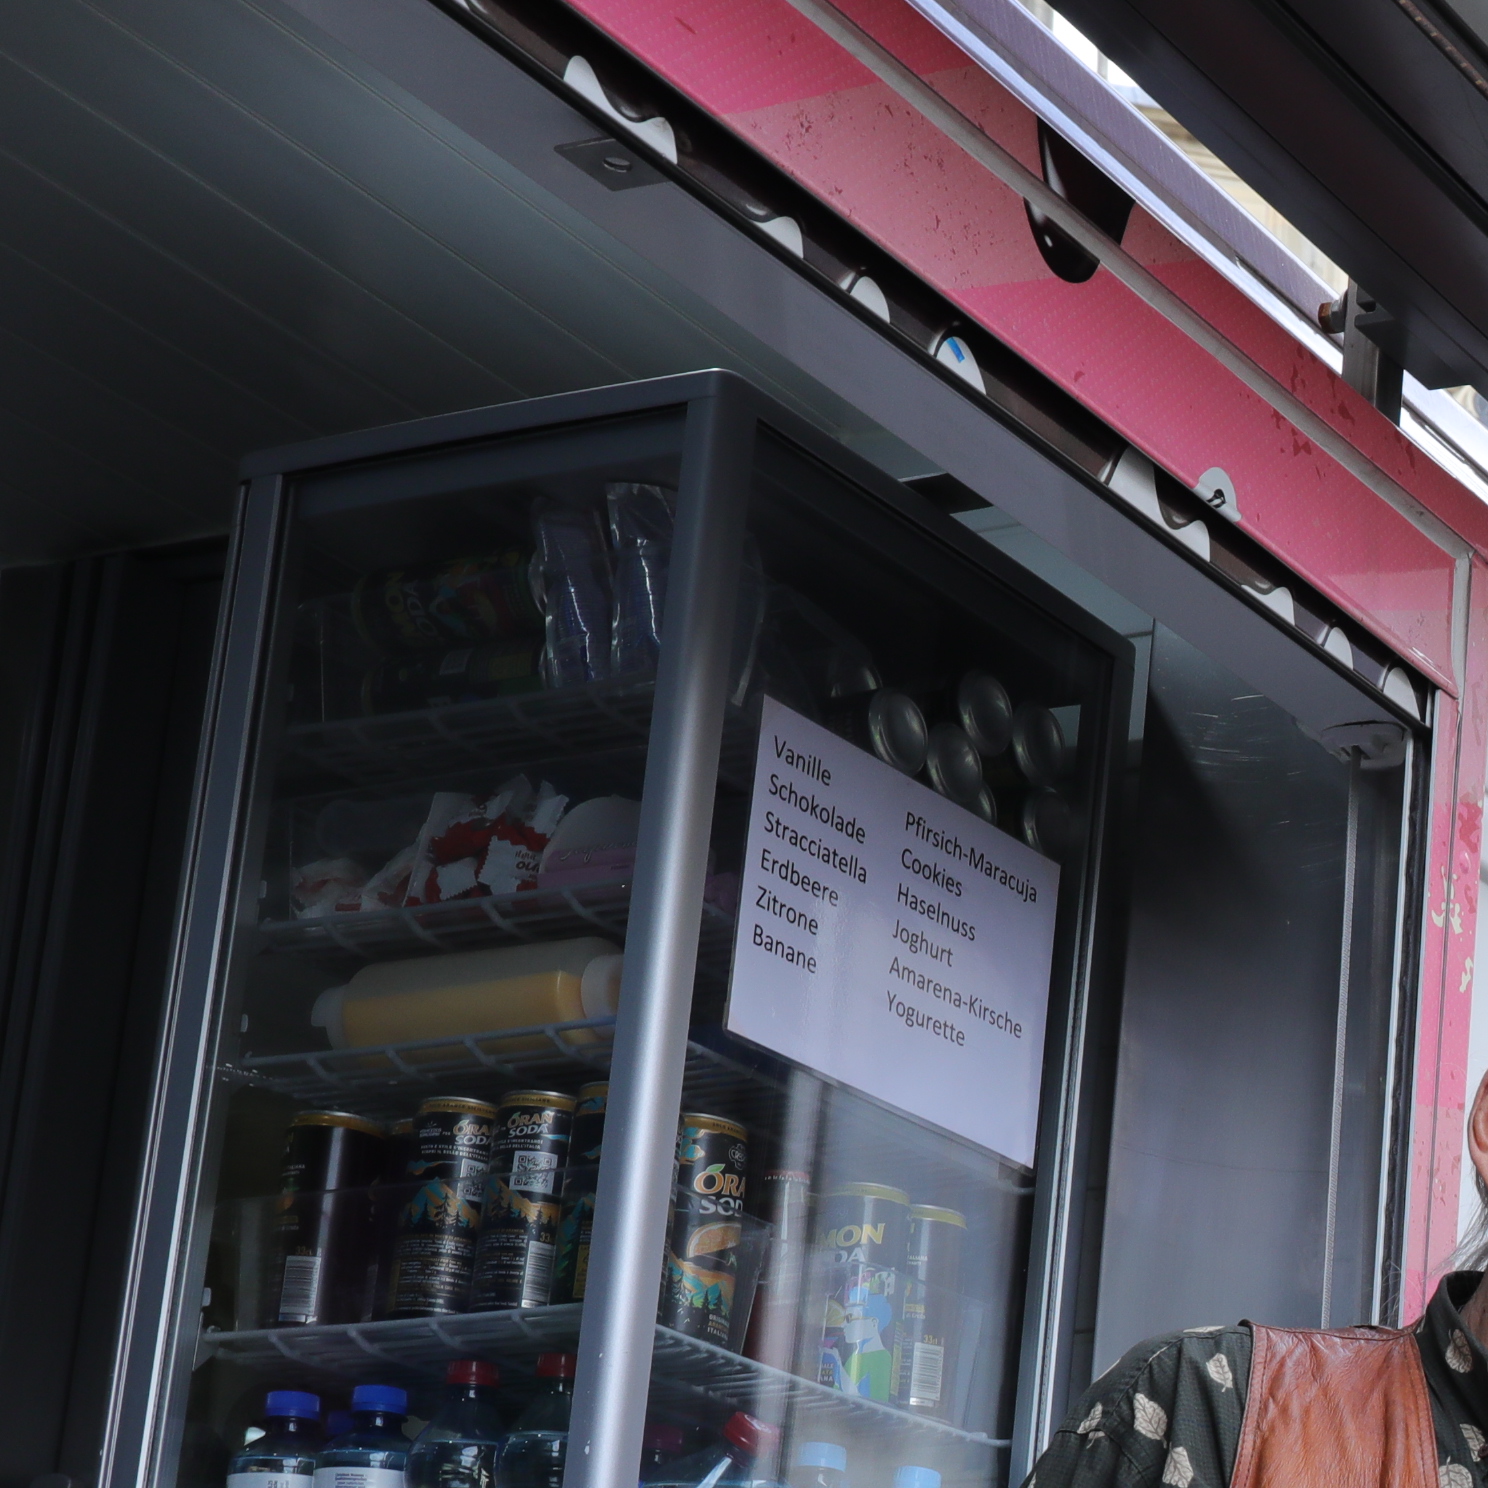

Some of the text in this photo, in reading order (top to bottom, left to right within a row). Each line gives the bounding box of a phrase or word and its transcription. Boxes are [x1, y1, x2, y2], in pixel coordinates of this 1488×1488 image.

[774, 734, 832, 787] Vanille
[768, 774, 866, 844] Schokolade
[764, 811, 867, 884] Stracciatella
[901, 848, 963, 898] Cookies
[905, 811, 1038, 904] Pfirsich-Maracuja
[760, 849, 839, 907] Erdbeere
[756, 885, 818, 936] Zitrone
[897, 883, 976, 941] Haselnuss
[753, 924, 817, 974] Banane
[892, 919, 954, 968] Joghurt
[886, 990, 966, 1047] Yogurette
[889, 956, 1023, 1040] Amarena-Kirsche
[507, 1112, 555, 1128] ORAN
[508, 1125, 549, 1138] SODA
